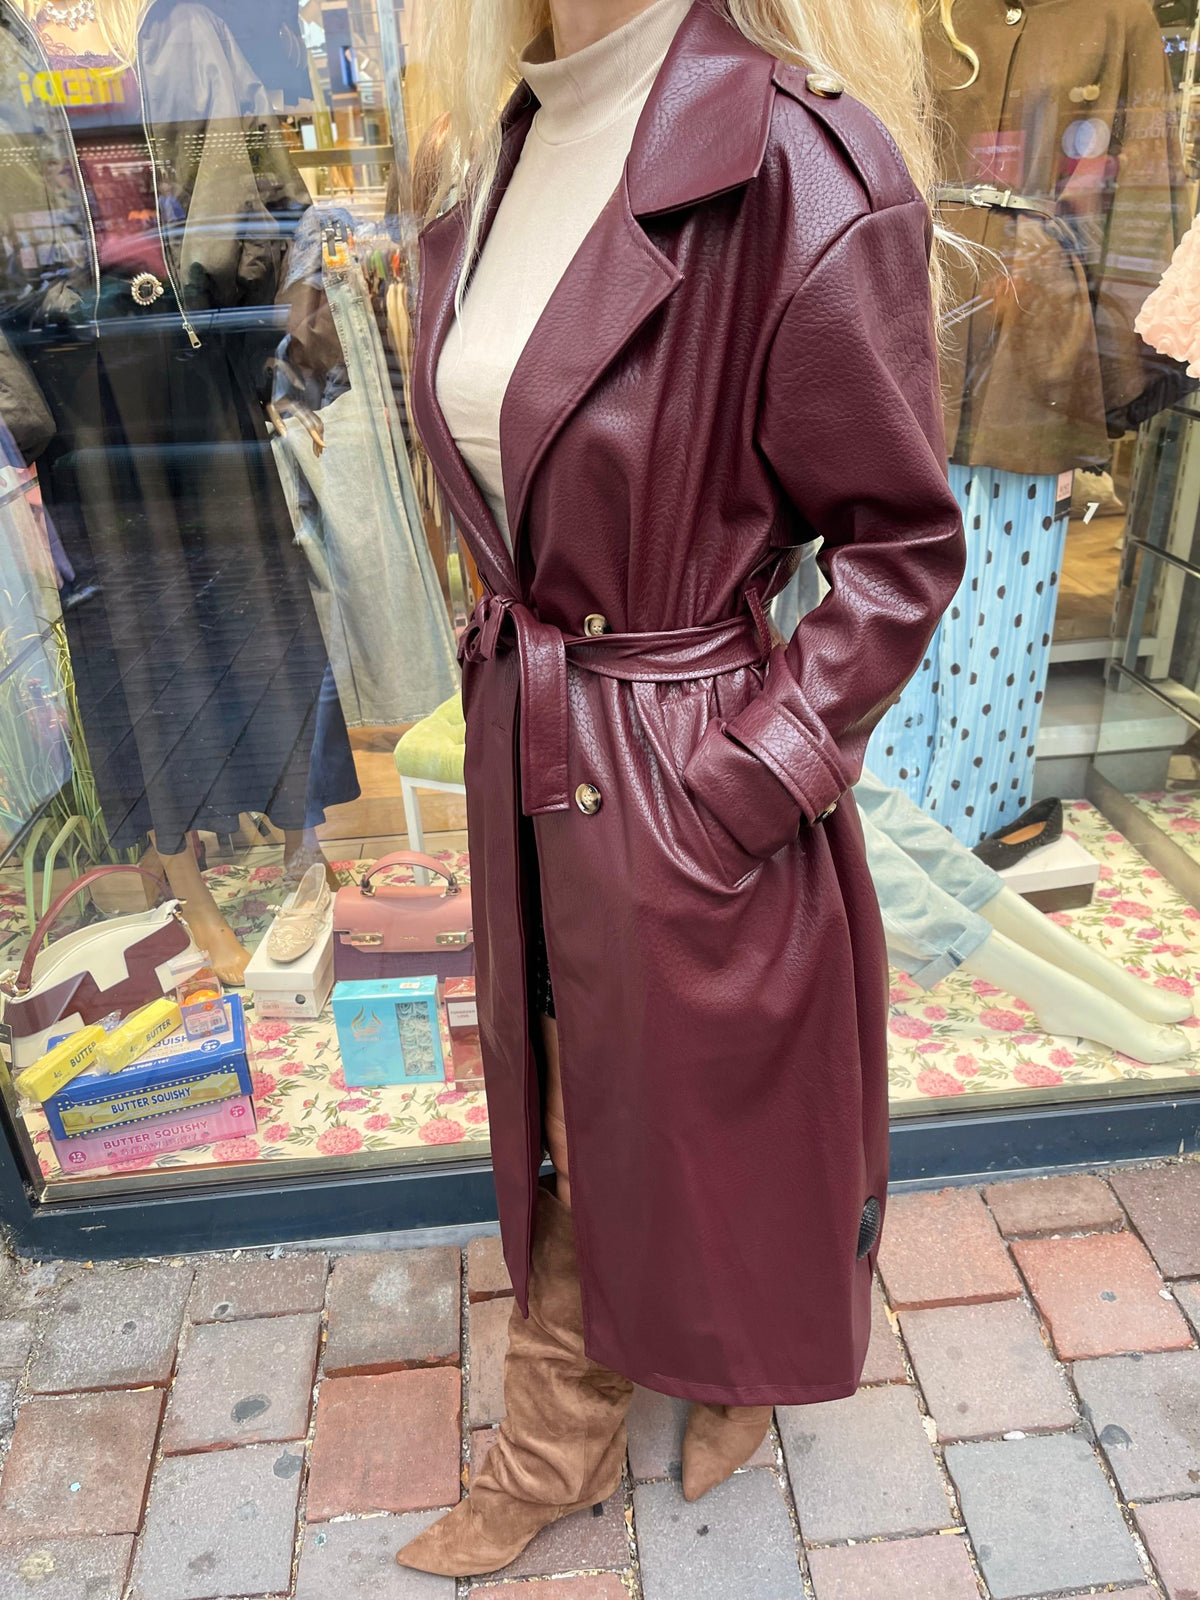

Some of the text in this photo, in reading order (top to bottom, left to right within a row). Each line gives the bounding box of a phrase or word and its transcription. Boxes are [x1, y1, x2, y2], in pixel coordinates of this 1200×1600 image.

[146, 1018, 172, 1042] BUTTER
[154, 1035, 188, 1048] UISH
[69, 1041, 97, 1067] BUTTER
[111, 1097, 150, 1114] BUTTER
[151, 1087, 191, 1104] SQUISHY
[103, 1121, 207, 1150] BUTTER SQUISHY
